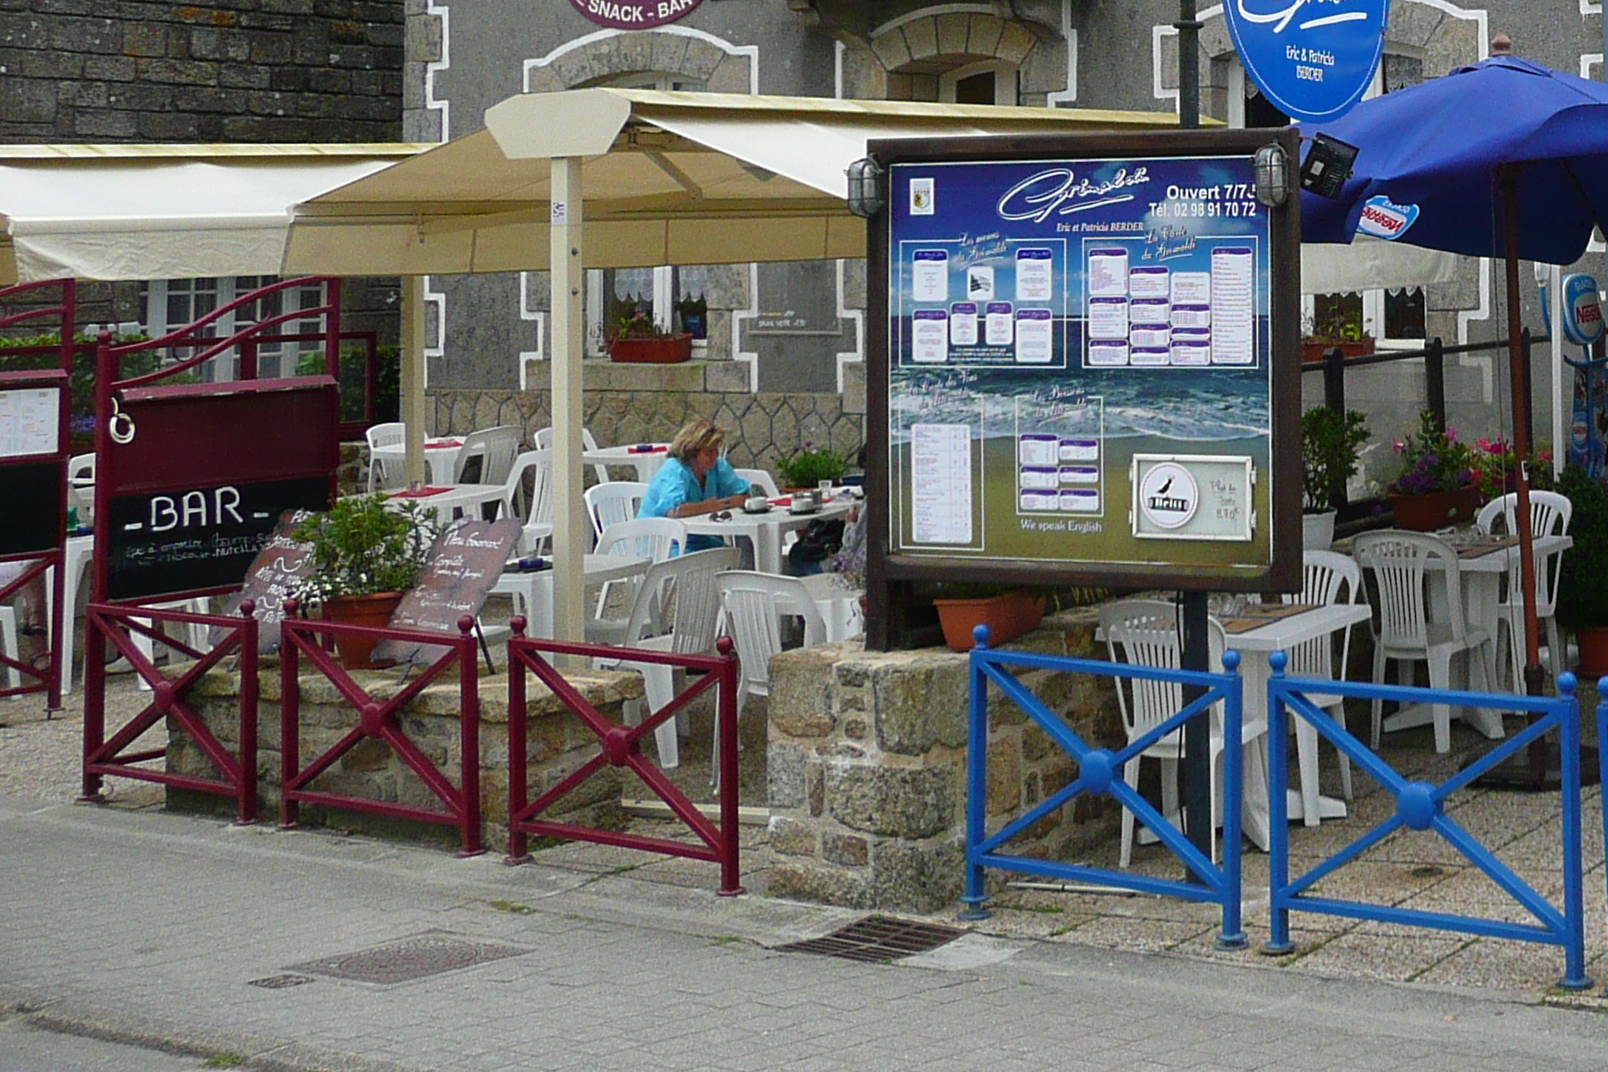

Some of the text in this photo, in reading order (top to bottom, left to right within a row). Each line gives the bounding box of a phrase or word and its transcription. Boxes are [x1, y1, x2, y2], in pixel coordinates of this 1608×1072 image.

[1286, 44, 1300, 60] Eric
[1166, 184, 1220, 201] Ouvert
[1149, 201, 1256, 218] Tél. 02 98 91 70 72
[1056, 222, 1144, 233] Eric et Patricia BERDER
[151, 486, 244, 532] BAR
[1020, 518, 1103, 534] We speak English
